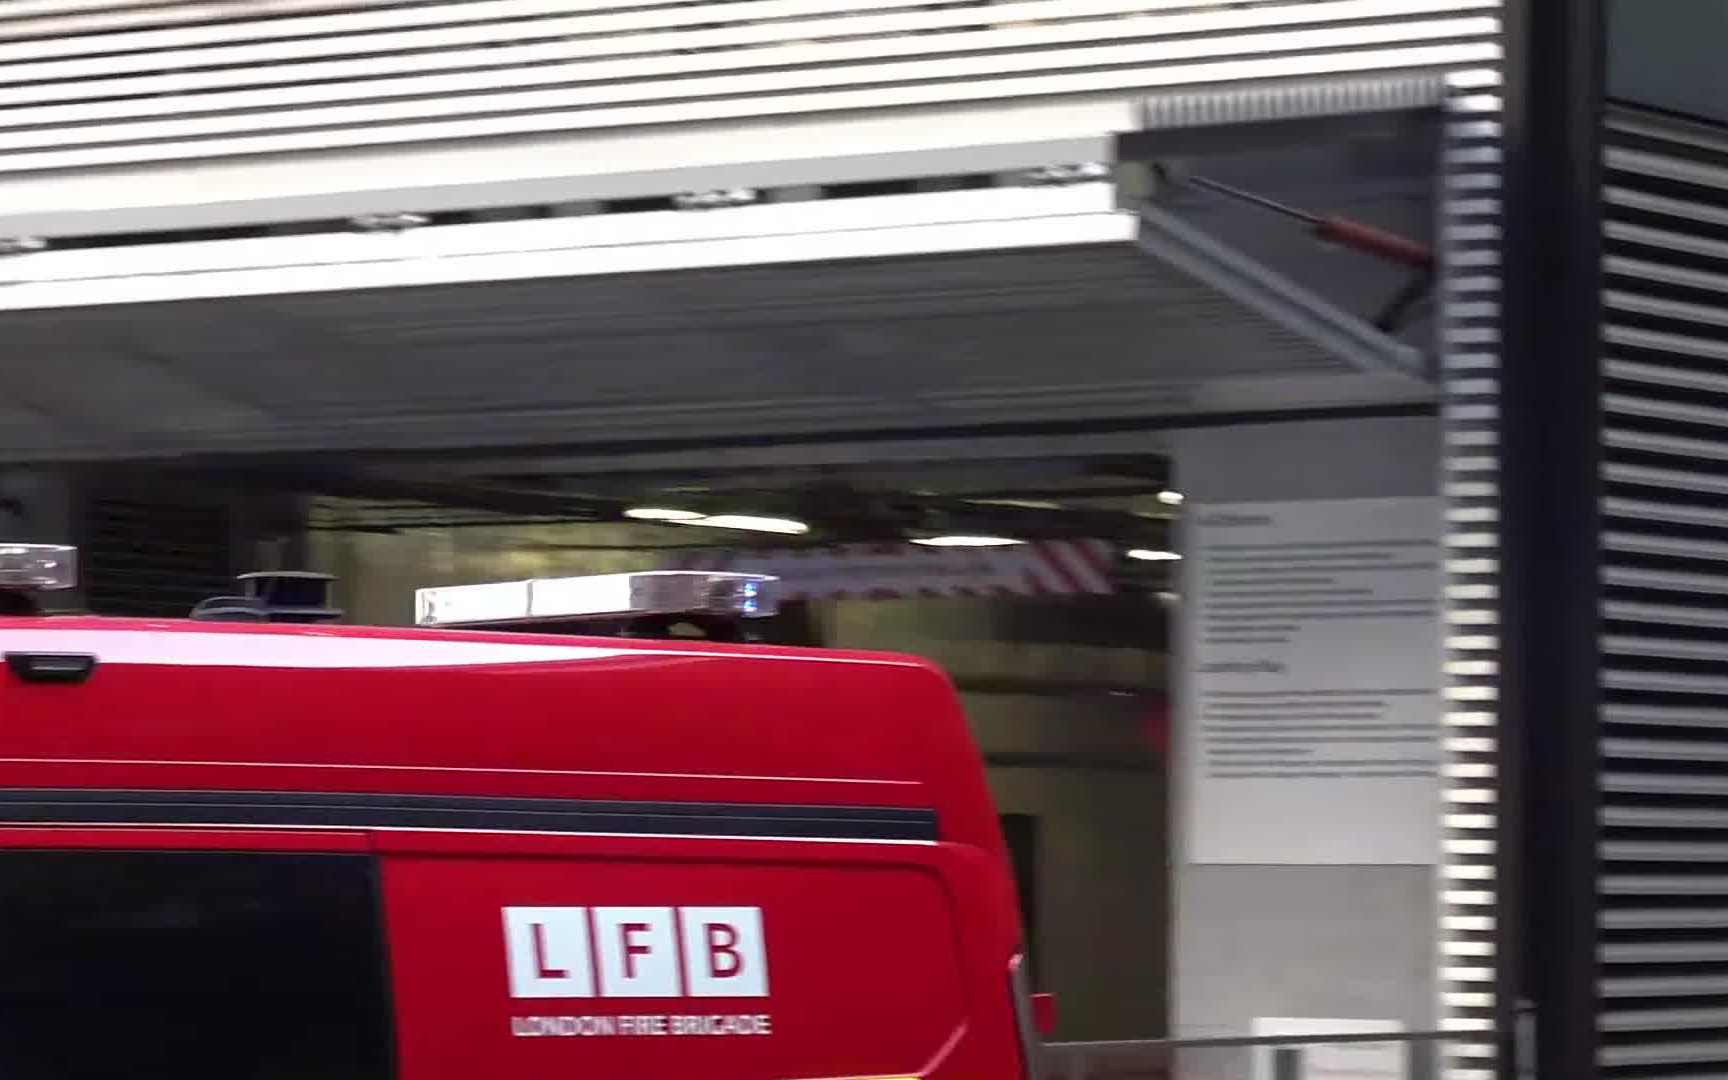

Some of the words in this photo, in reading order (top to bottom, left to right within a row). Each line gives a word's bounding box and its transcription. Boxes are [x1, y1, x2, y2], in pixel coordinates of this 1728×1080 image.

[526, 919, 746, 981] LFB
[510, 1015, 616, 1037] LONDON
[618, 1015, 668, 1036] FIRE
[671, 1014, 772, 1035] BRIGADE
